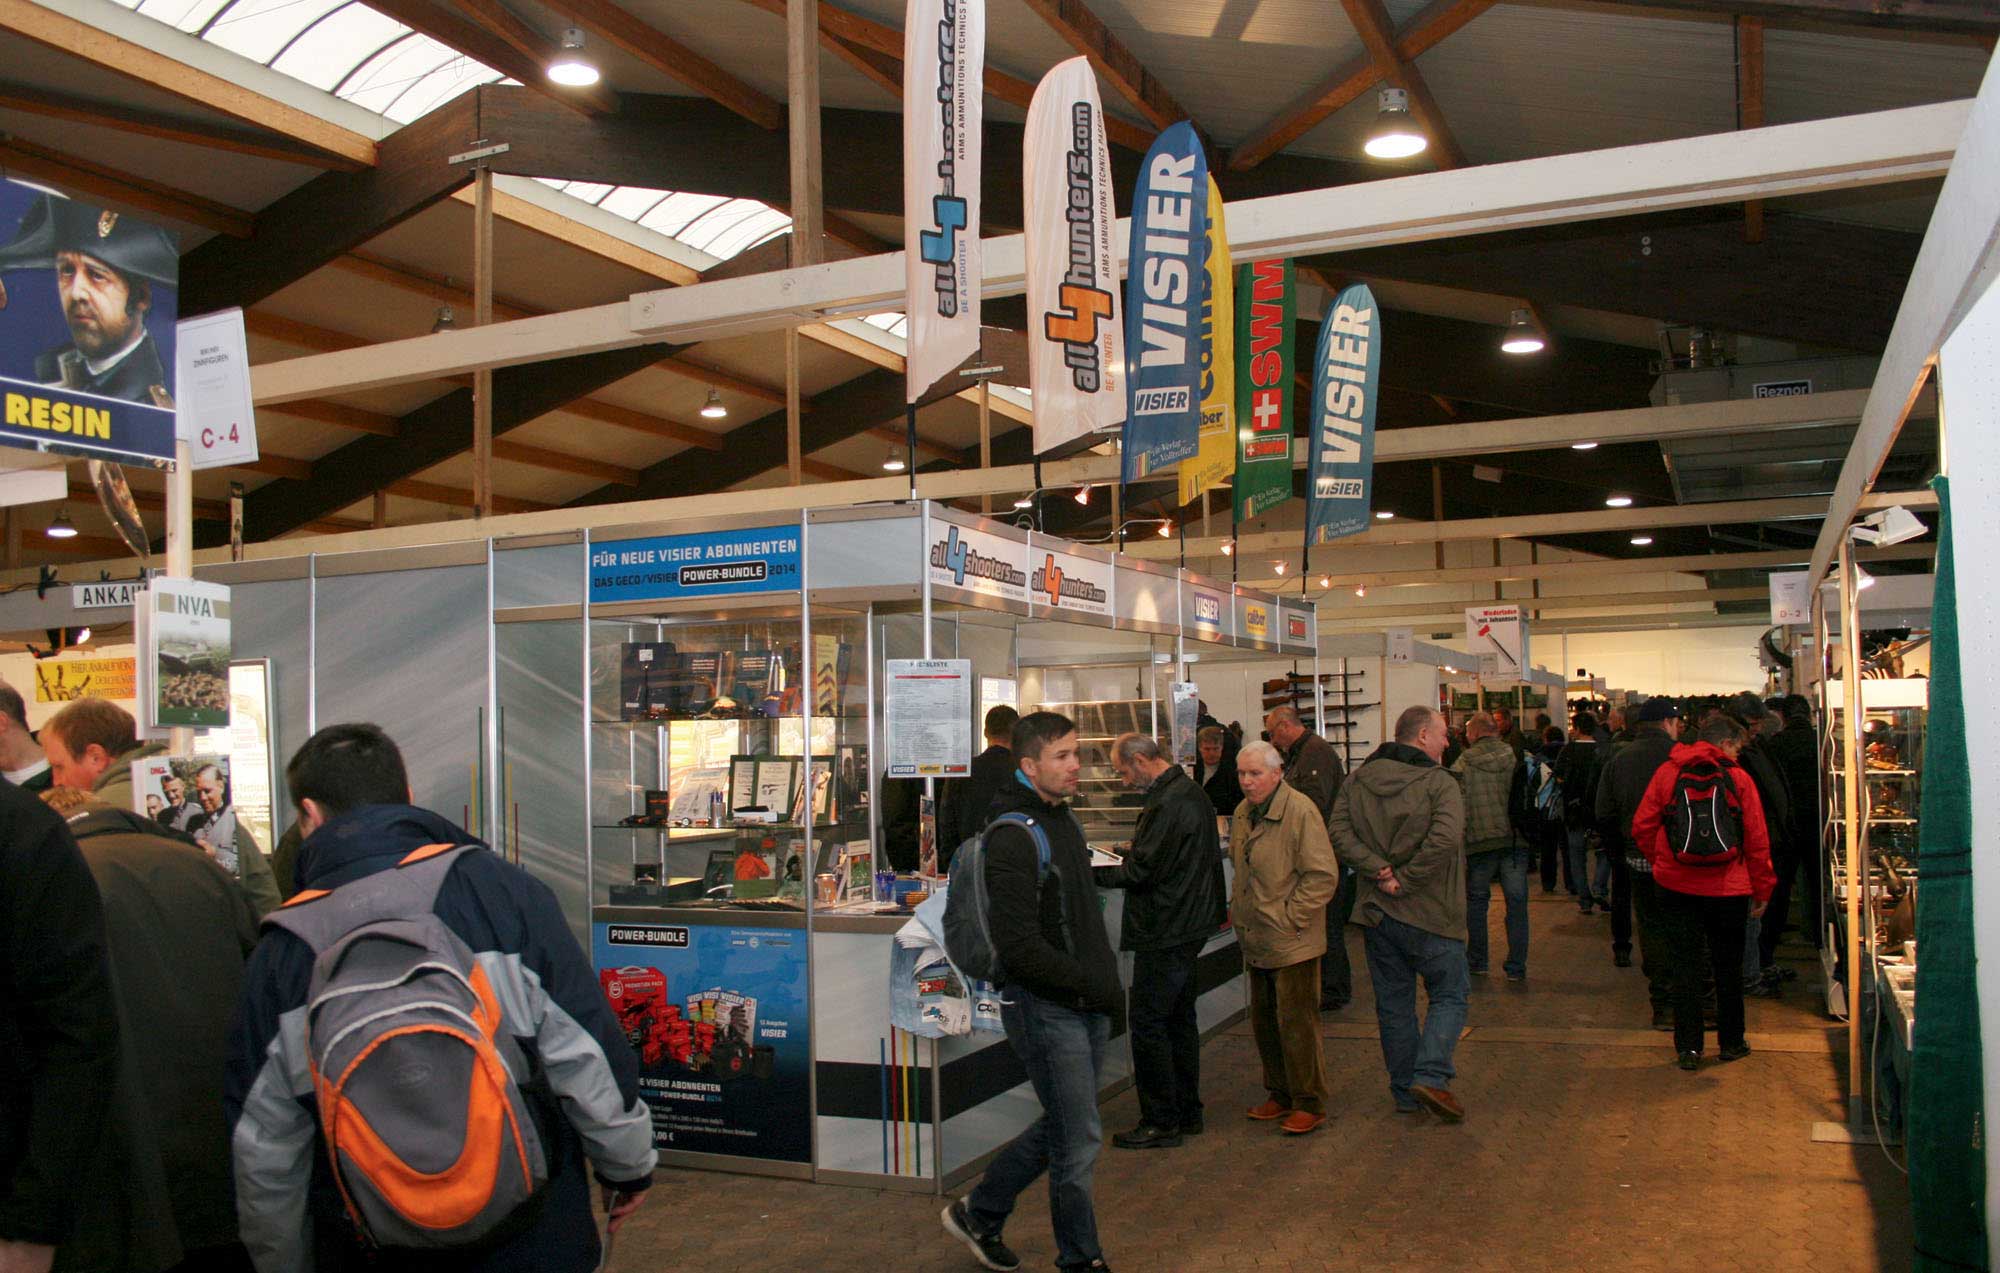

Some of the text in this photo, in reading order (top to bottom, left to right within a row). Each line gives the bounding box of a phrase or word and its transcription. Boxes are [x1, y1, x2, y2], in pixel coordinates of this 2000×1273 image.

[959, 8, 967, 54] TECHNICS
[958, 59, 966, 128] AMMUNITIONS
[1098, 149, 1107, 187] TECHNICS
[1100, 189, 1110, 249] AMMUNITIONS
[959, 239, 967, 285] SHOOTER
[1044, 101, 1114, 394] all4hunters.com
[1140, 152, 1196, 368] VISIER
[1102, 251, 1110, 278] ARMS
[1321, 303, 1372, 464] VISIER
[1757, 384, 1808, 398] Reznor
[5, 393, 111, 440] RESIN
[1135, 391, 1188, 411] VISIER
[1316, 482, 1362, 496] VISIER
[592, 539, 797, 567] FÜR NEUE VISIER ABONNENTEN
[930, 525, 1027, 587] all4shooters.com
[594, 576, 614, 588] DAS
[683, 565, 763, 582] POWER-BUNDLE
[769, 563, 796, 576] 2014
[1031, 553, 1106, 606] all4hunters.com
[178, 594, 212, 618] NVA
[1196, 597, 1219, 621] VISIER
[611, 929, 686, 943] POWER-BUNDLE
[761, 1028, 787, 1038] VISIER
[646, 1078, 670, 1088] VISIER
[671, 1080, 721, 1092] ABONNENTEN
